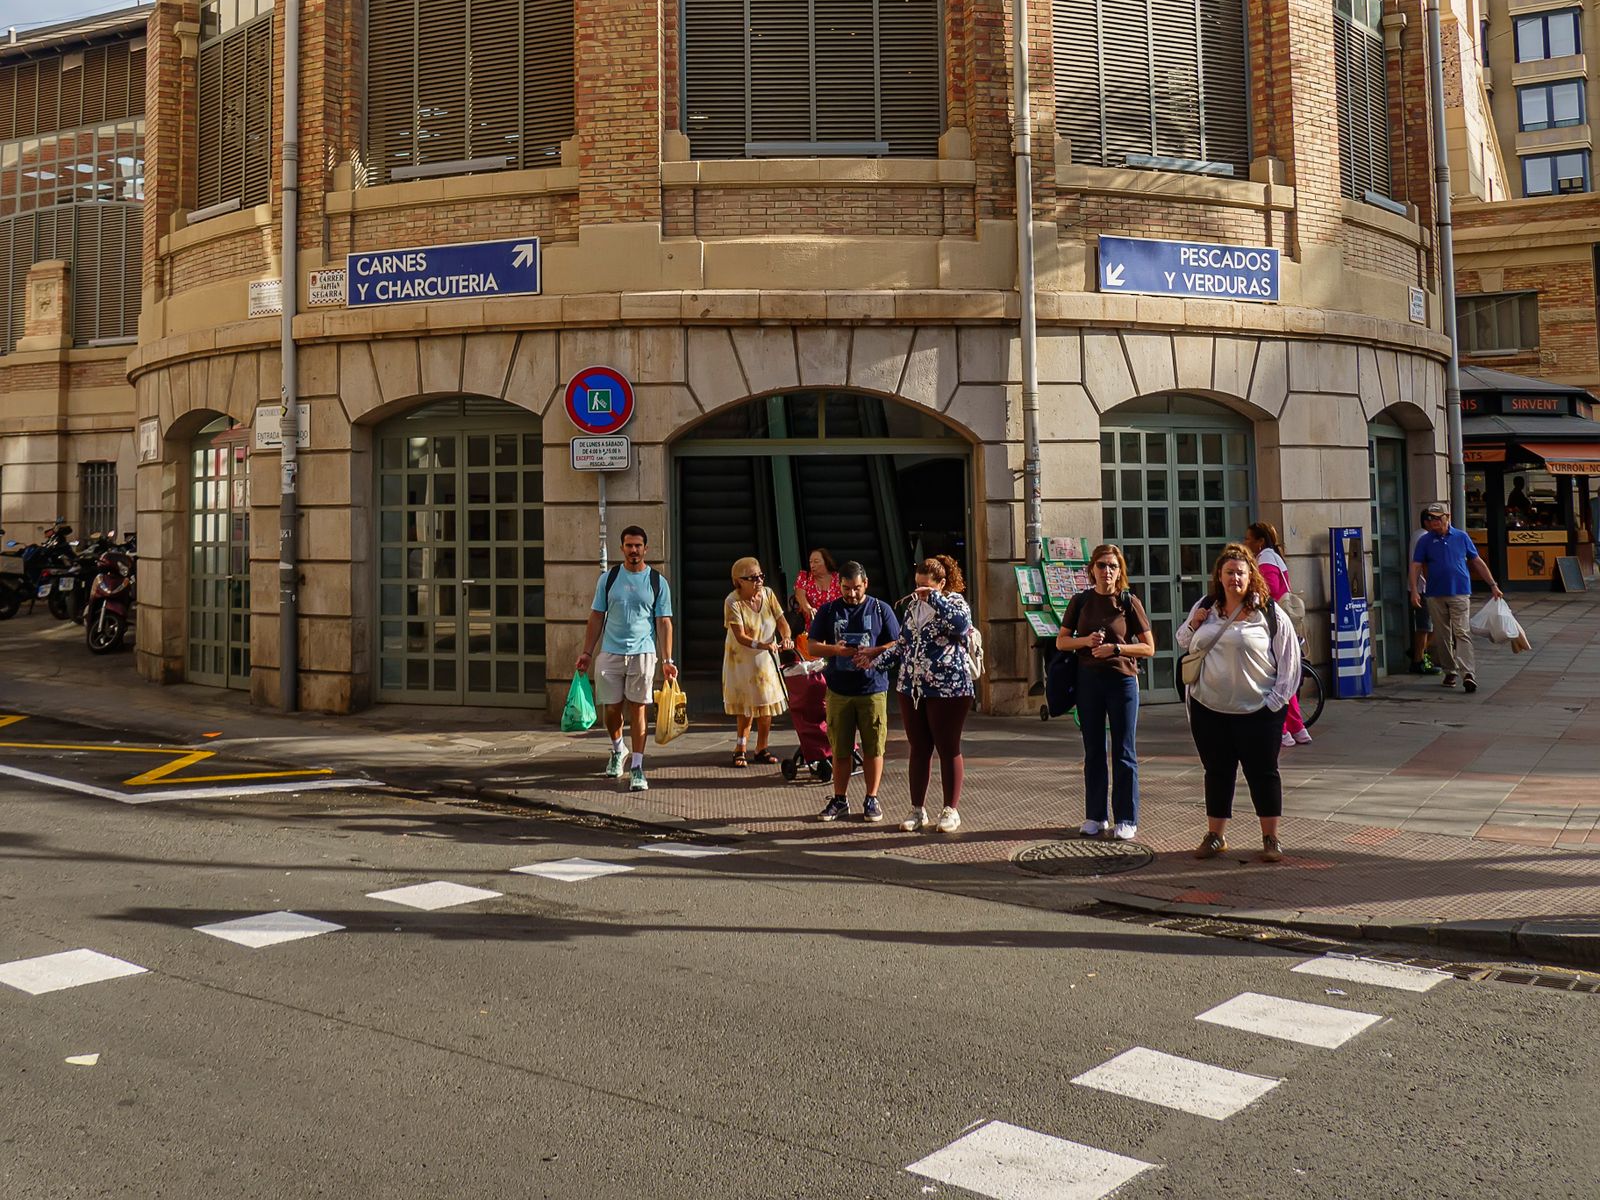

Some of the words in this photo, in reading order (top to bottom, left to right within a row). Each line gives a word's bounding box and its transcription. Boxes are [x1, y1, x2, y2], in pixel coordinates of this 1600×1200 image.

[357, 253, 427, 276] CARNES
[1180, 247, 1271, 272] PESCADOS
[319, 274, 344, 283] CARRER
[356, 283, 369, 301] Y
[375, 272, 499, 300] CHARCUTERIA
[1164, 271, 1176, 290] Y
[1182, 272, 1271, 296] VERDURAS
[312, 290, 343, 299] SEGARRA
[1512, 398, 1559, 410] SIRVENT
[257, 432, 280, 441] ENTRADA
